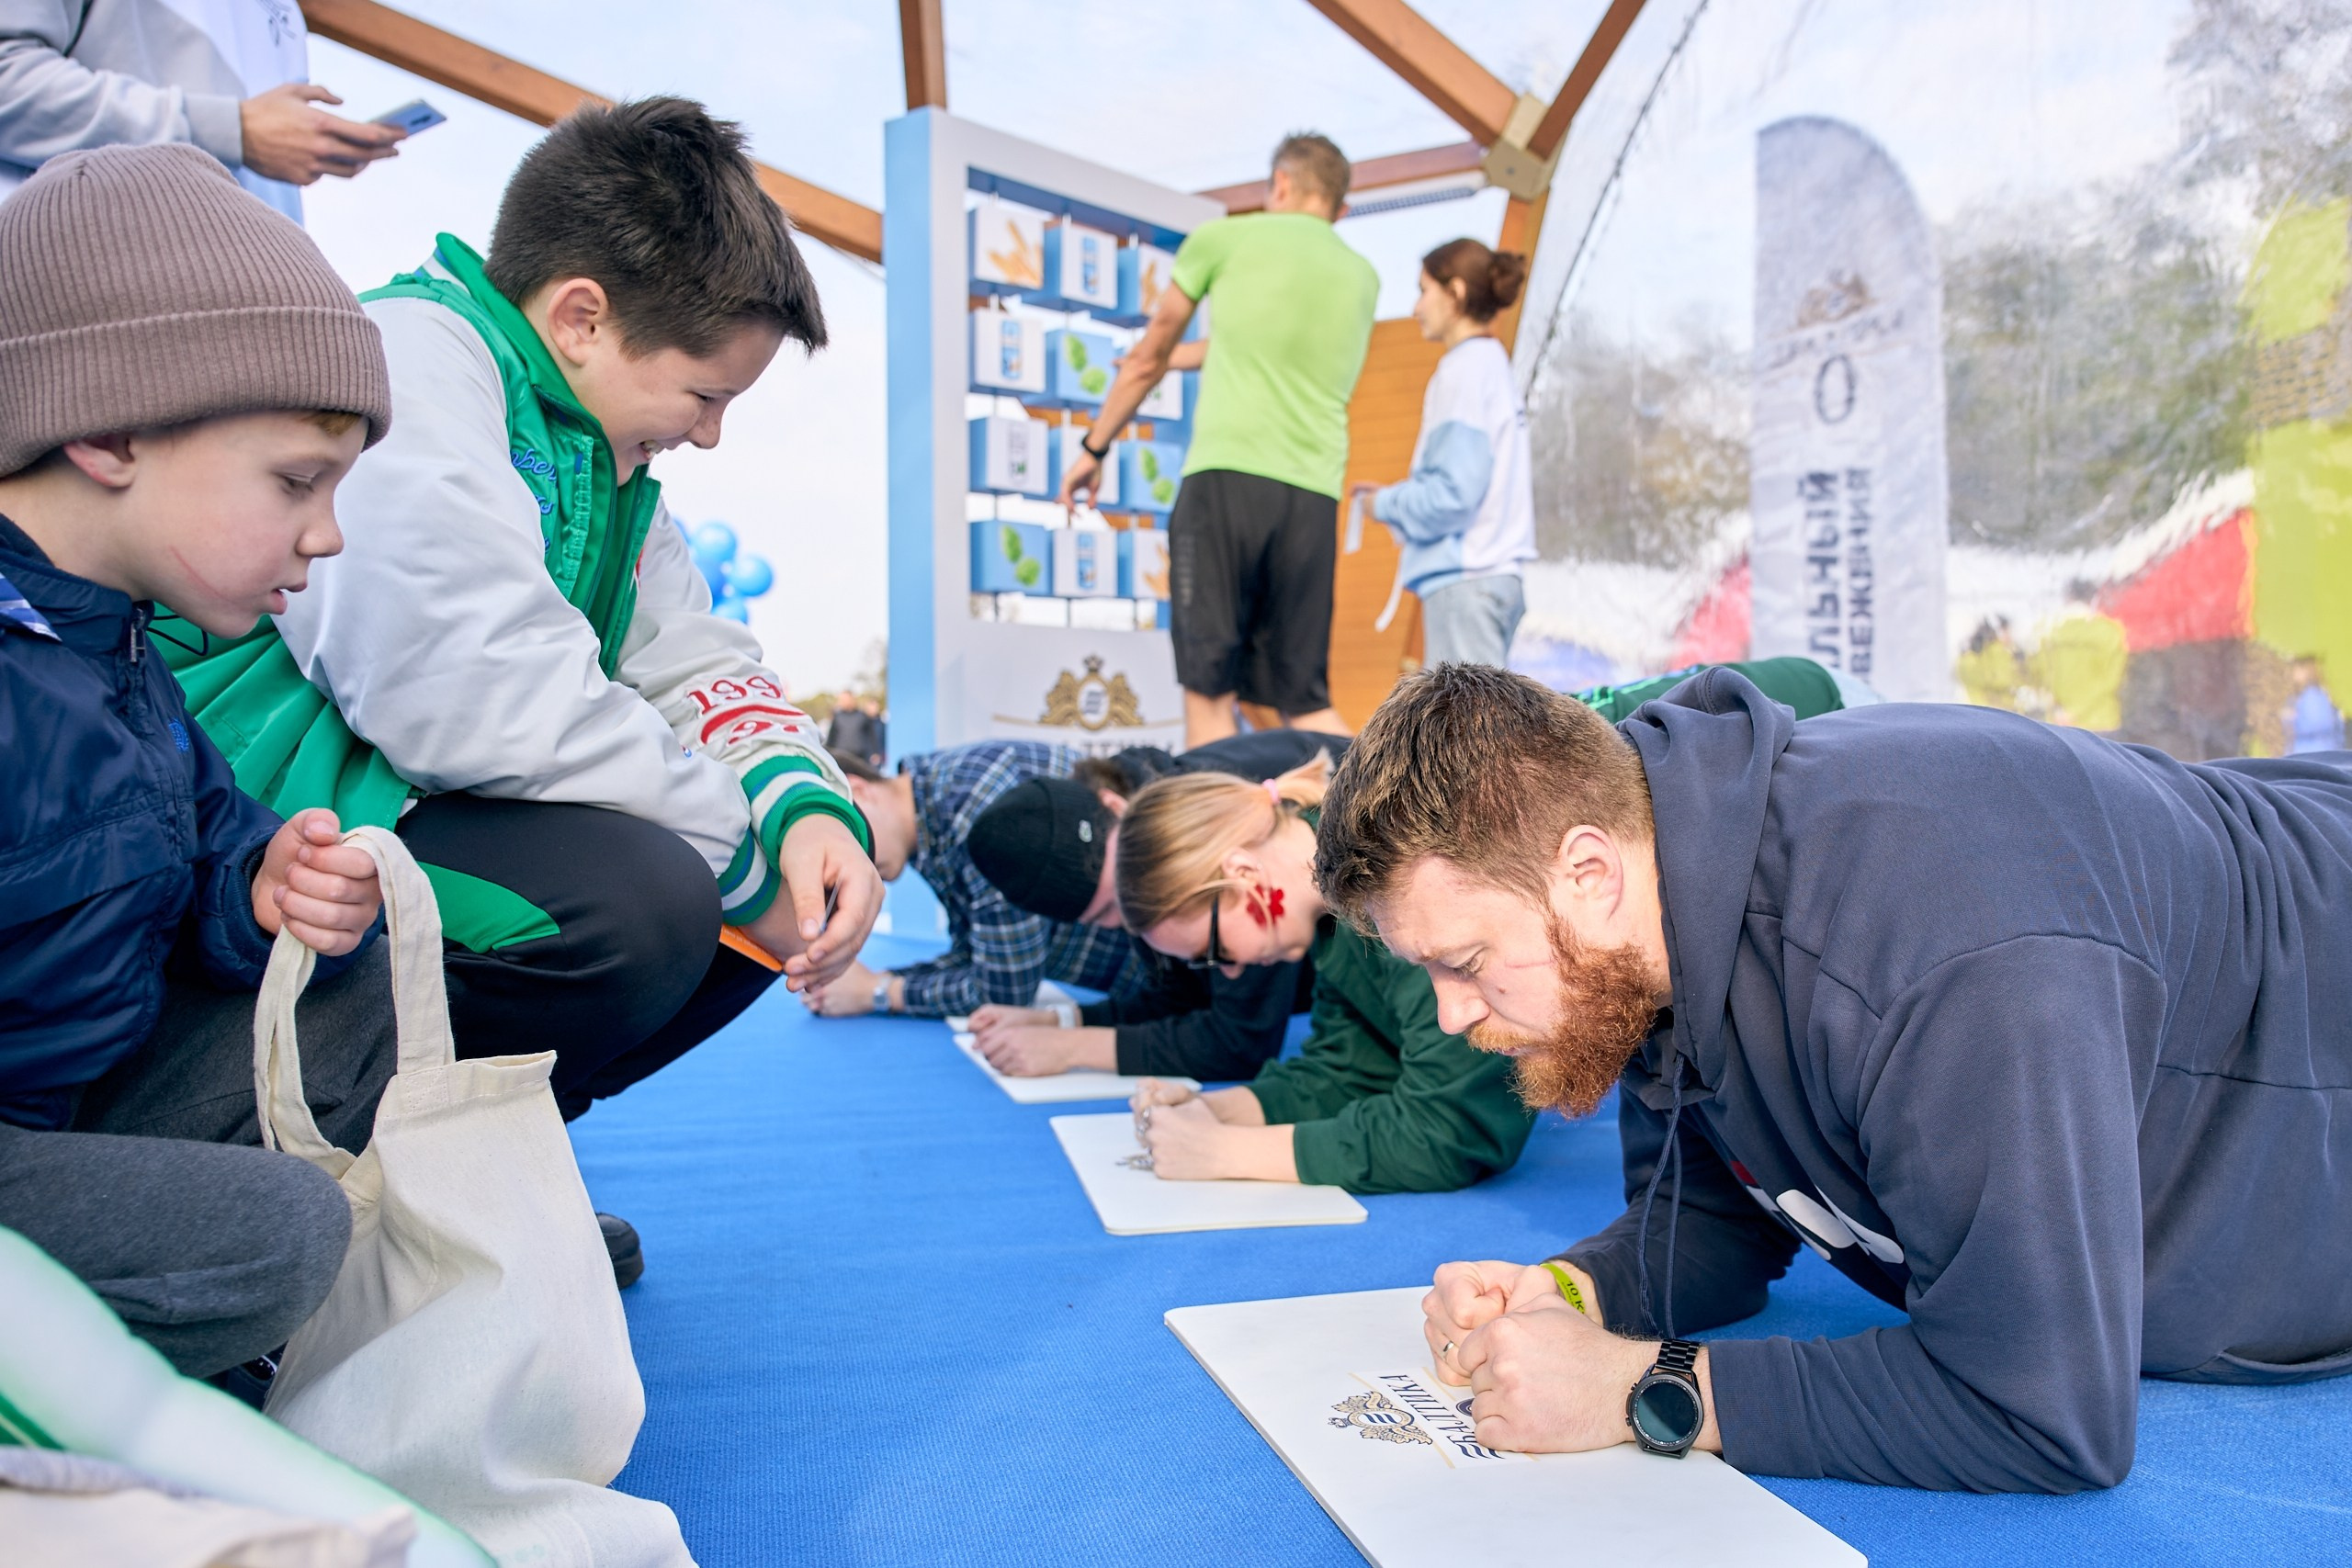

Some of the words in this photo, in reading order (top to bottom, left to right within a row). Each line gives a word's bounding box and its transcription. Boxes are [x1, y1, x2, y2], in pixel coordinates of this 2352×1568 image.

[1797, 470, 1840, 670] ЛЬНЫЙ
[1845, 467, 1872, 683] ВЕЖЕНИЯ
[1566, 1280, 1579, 1296] 10
[1378, 1374, 1478, 1444] БАЛТИКА
